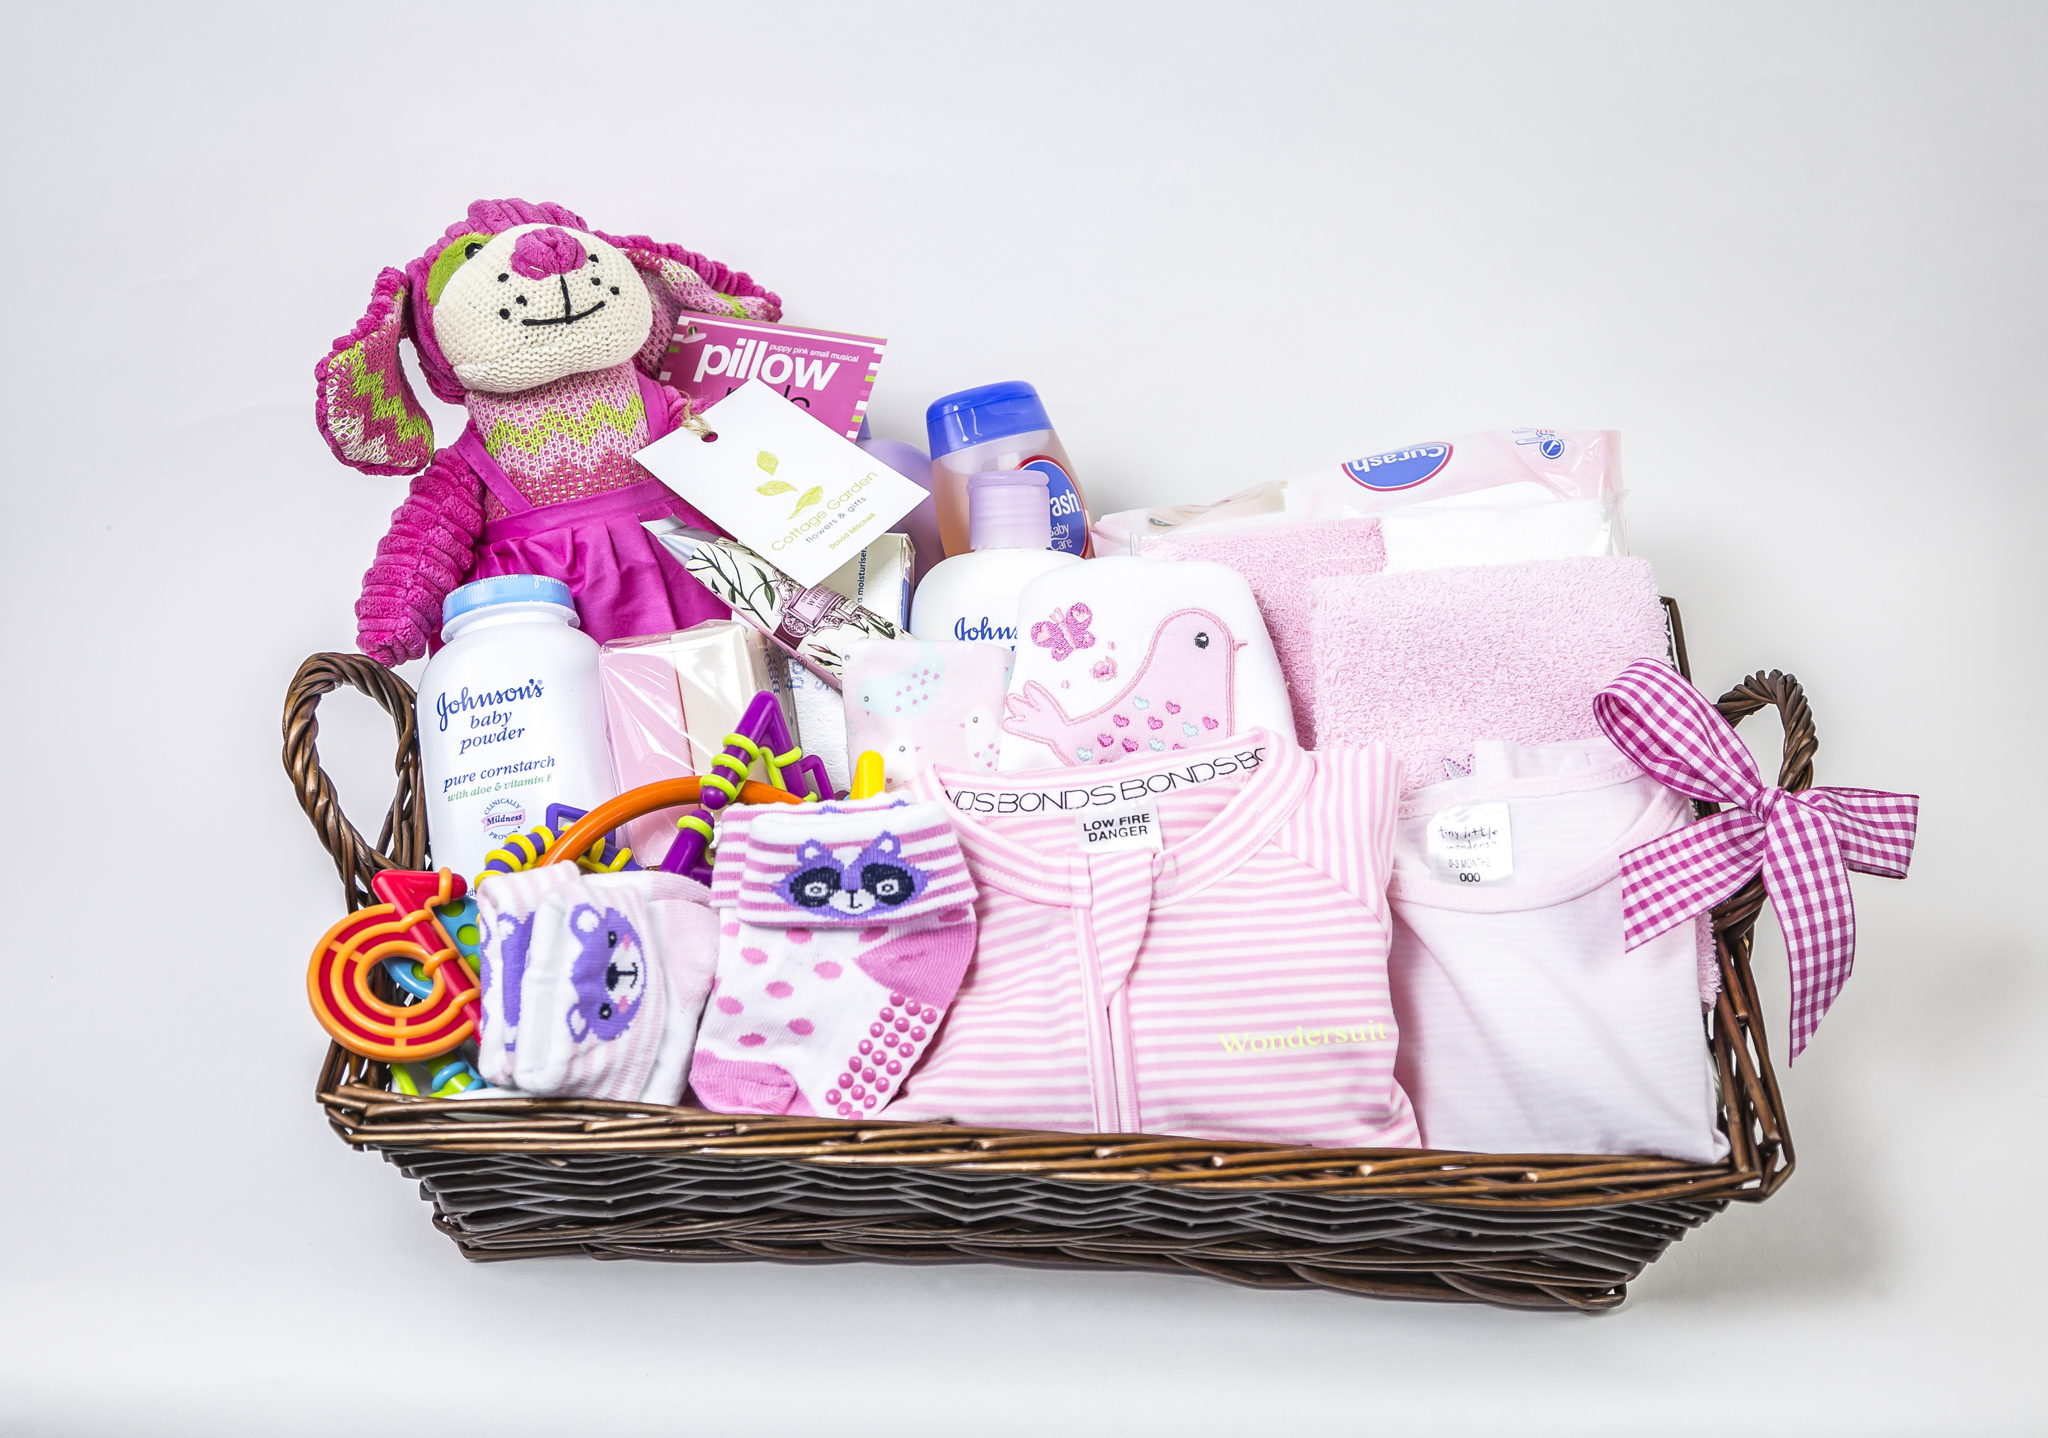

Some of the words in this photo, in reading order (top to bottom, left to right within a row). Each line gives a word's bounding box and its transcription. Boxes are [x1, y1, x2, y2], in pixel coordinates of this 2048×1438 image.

[693, 338, 841, 391] pillow
[769, 344, 792, 354] puppy
[792, 347, 809, 355] pink
[810, 349, 830, 358] small
[831, 353, 859, 363] musical
[1352, 446, 1445, 473] Curash
[771, 511, 828, 551] Cottage
[826, 472, 878, 511] Garden
[1050, 489, 1081, 517] ash
[805, 518, 838, 543] flowers
[838, 512, 847, 520] &
[847, 496, 867, 513] gifts
[828, 531, 850, 550] David
[848, 512, 876, 534] Mitchell
[857, 546, 867, 596] moisturiser
[954, 616, 1018, 641] John
[436, 679, 545, 732] Johnson's
[470, 710, 512, 730] baby
[459, 726, 525, 755] powder
[443, 772, 476, 794] pure
[480, 756, 555, 780] cornstarch
[447, 789, 468, 802] with
[470, 785, 492, 797] aloe
[494, 782, 502, 791] &
[504, 775, 544, 790] vitamin
[546, 773, 553, 783] E
[997, 785, 1116, 813] BONDS
[1120, 757, 1238, 801] BONDS
[484, 798, 521, 815] CLINICALLY
[486, 814, 522, 826] Mildness
[1083, 819, 1115, 832] LOW
[1119, 813, 1151, 826] FIRE
[1088, 825, 1148, 842] DANGER
[1460, 872, 1481, 883] 000
[1218, 1019, 1388, 1055] Wondersuit
